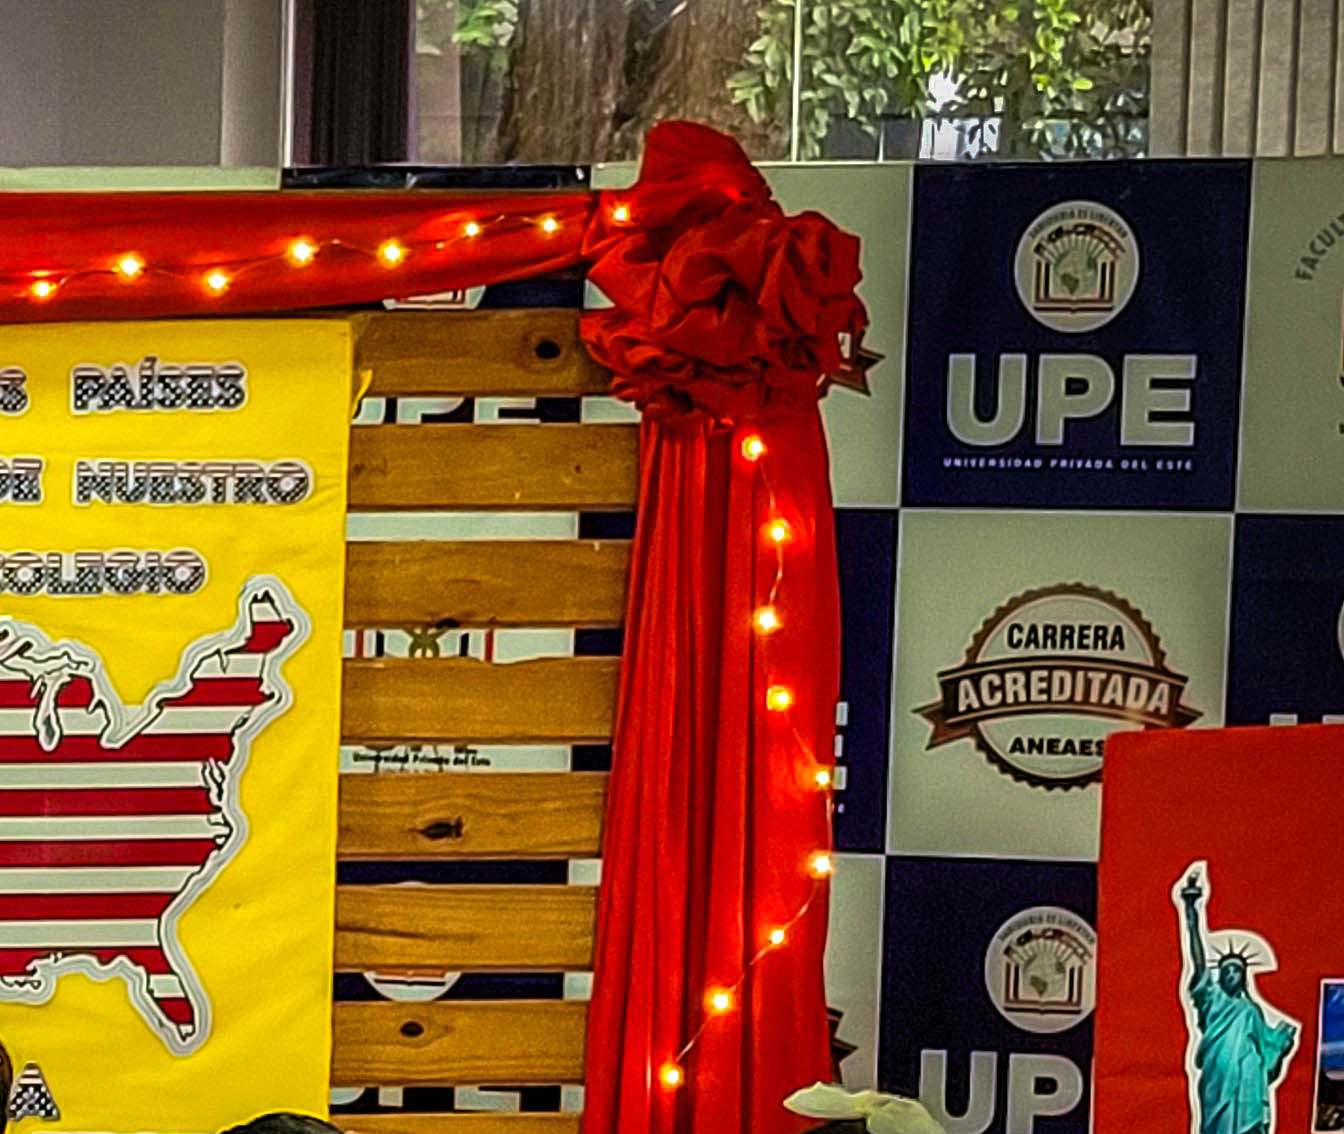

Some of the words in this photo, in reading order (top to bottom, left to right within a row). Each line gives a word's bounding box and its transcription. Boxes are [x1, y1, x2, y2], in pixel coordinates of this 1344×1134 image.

[73, 355, 246, 412] PAÍSES
[947, 353, 1197, 446] UPE
[74, 460, 311, 505] NUESTRO
[944, 457, 1042, 468] UNIVERSIDAD
[1050, 458, 1113, 469] PRIVADA
[1121, 459, 1147, 470] DEL
[1156, 459, 1193, 471] ESTE
[1006, 623, 1126, 652] CARRERA
[956, 669, 1171, 718] ACREDITADA
[1008, 735, 1106, 758] ANEAES
